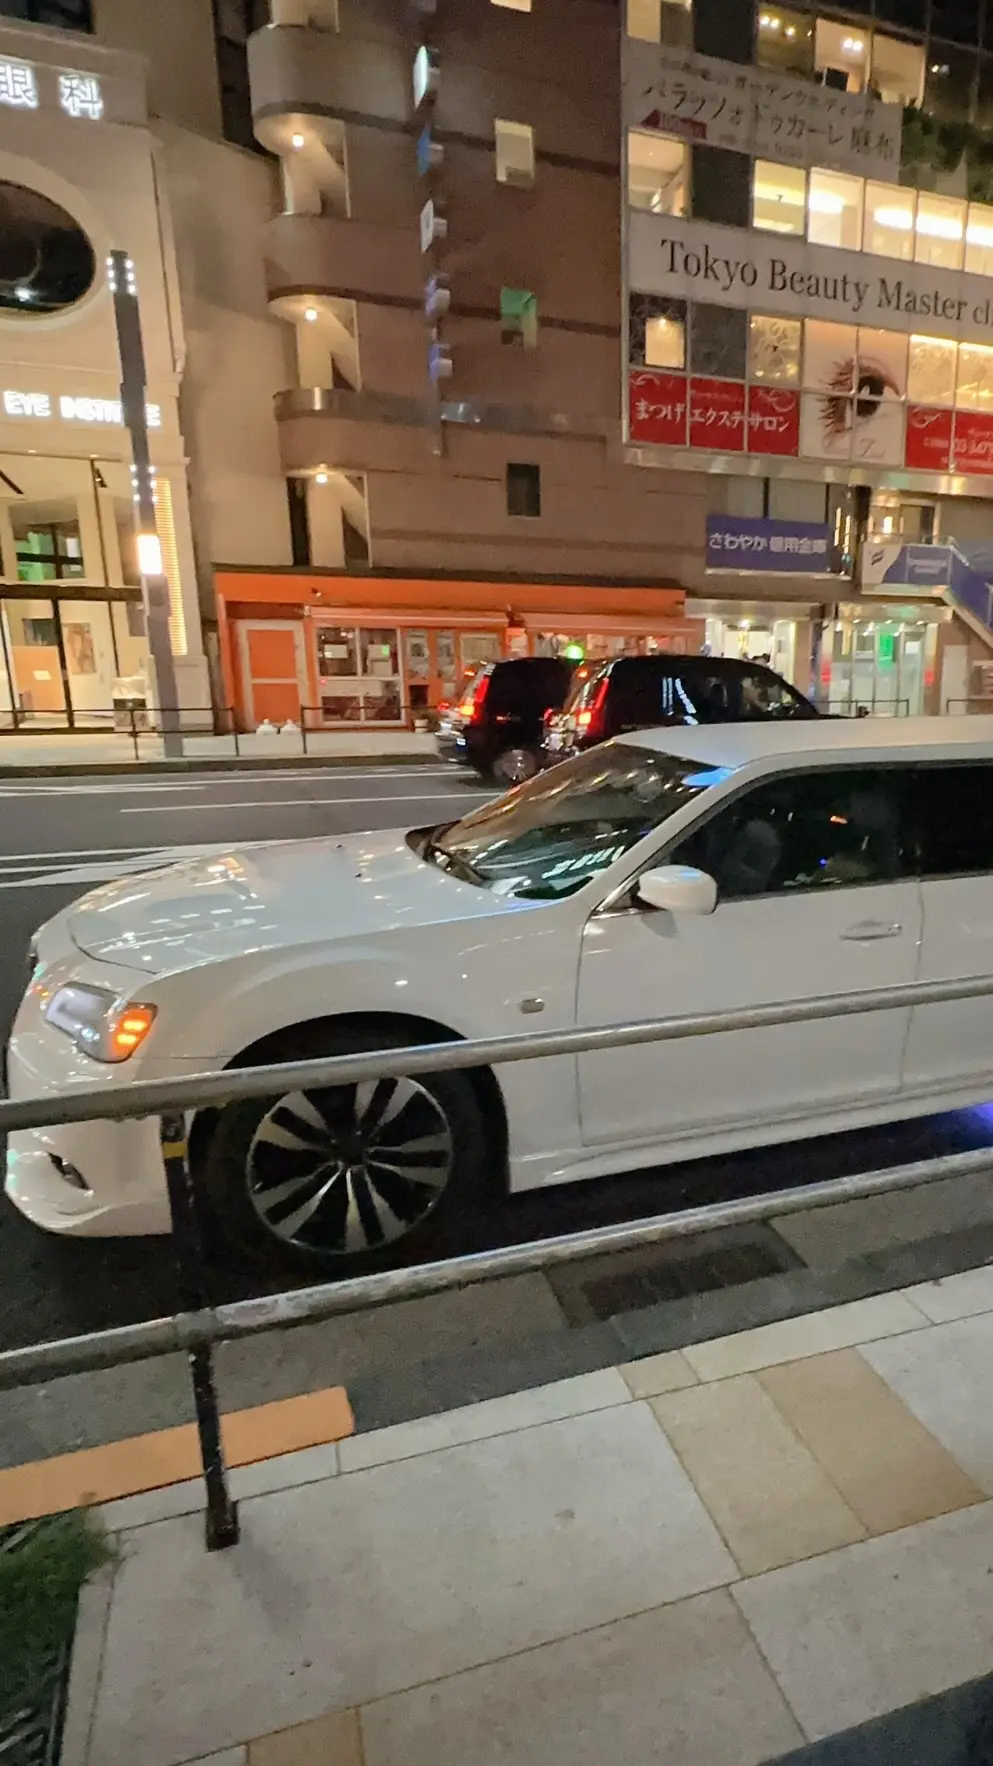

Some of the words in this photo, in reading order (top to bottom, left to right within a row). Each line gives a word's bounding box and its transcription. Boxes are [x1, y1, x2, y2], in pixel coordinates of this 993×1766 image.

[660, 237, 758, 291] Tokyo
[768, 258, 870, 312] Beauty
[877, 277, 968, 321] Master
[972, 299, 993, 327] cl
[3, 391, 51, 417] EYE
[635, 397, 790, 433] まつげエクステサロン
